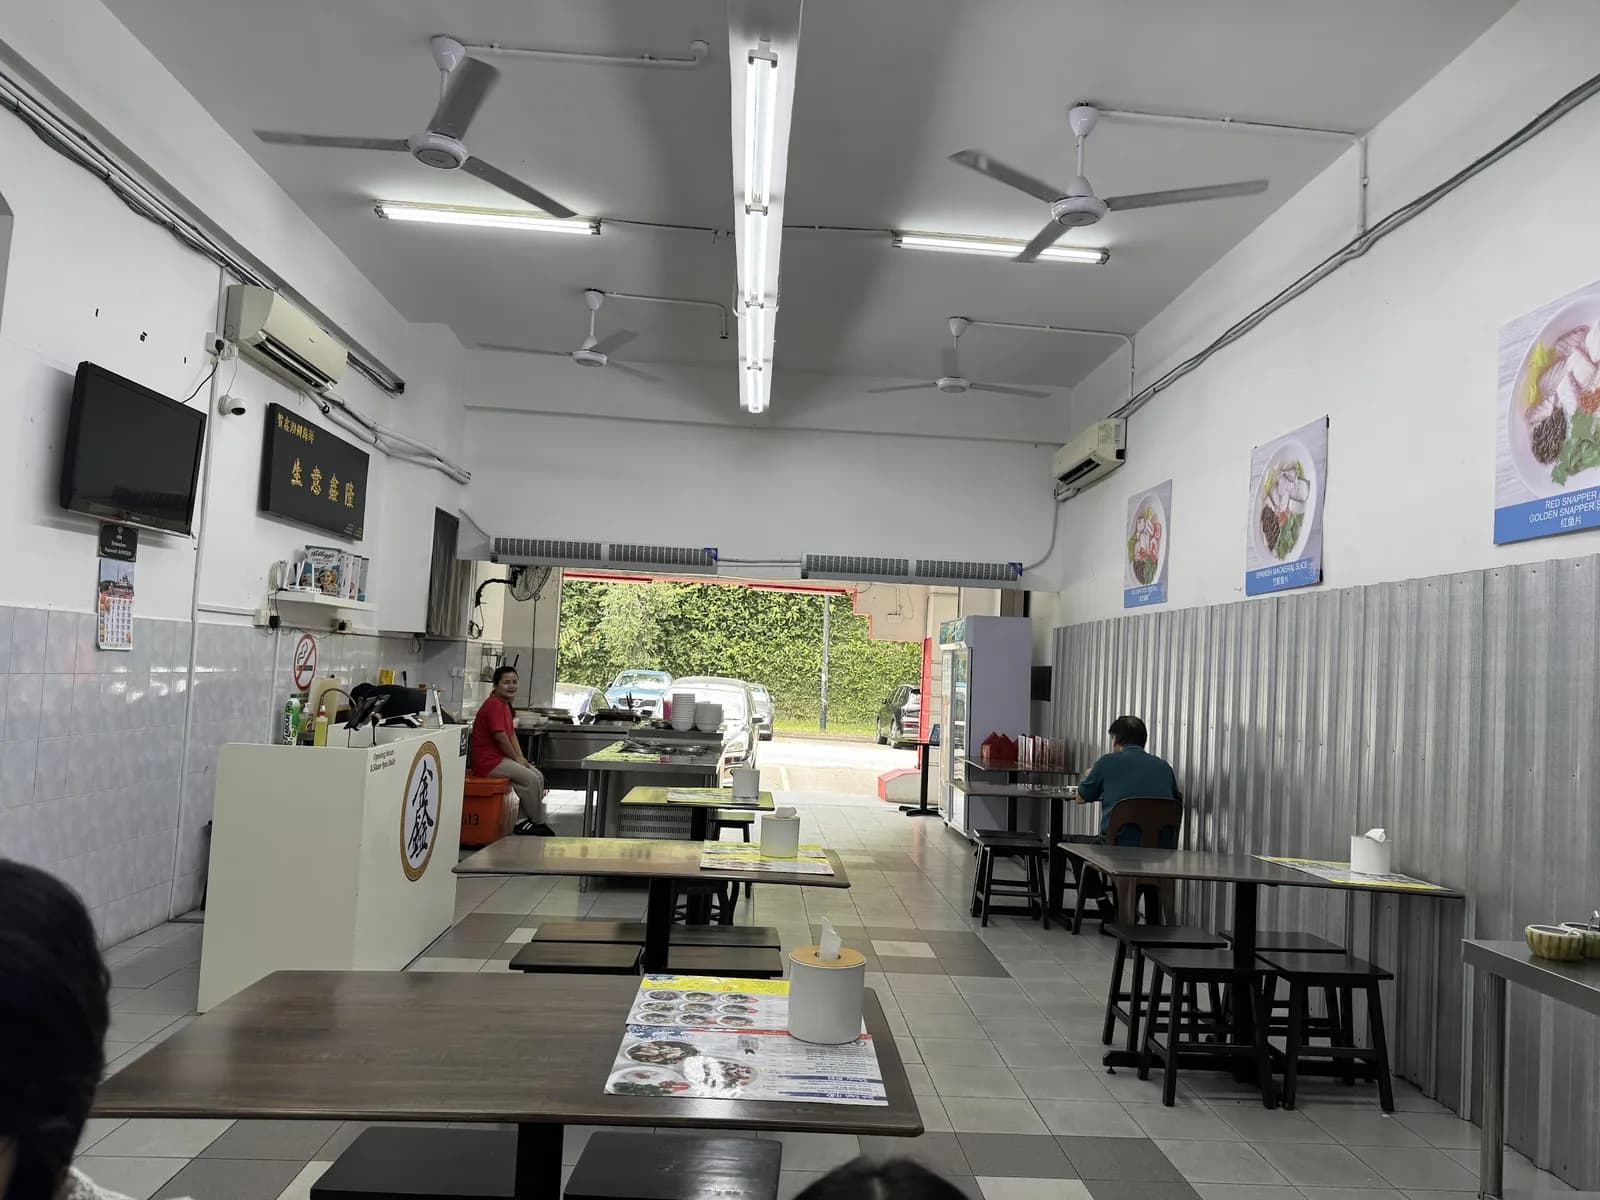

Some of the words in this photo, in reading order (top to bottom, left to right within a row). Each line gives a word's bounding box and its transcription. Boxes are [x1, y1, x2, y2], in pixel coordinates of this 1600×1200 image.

[1545, 499, 1560, 510] RED
[1561, 490, 1597, 507] SNAPPER
[1529, 510, 1559, 523] GOLDEN
[1560, 500, 1595, 517] SNAPPER
